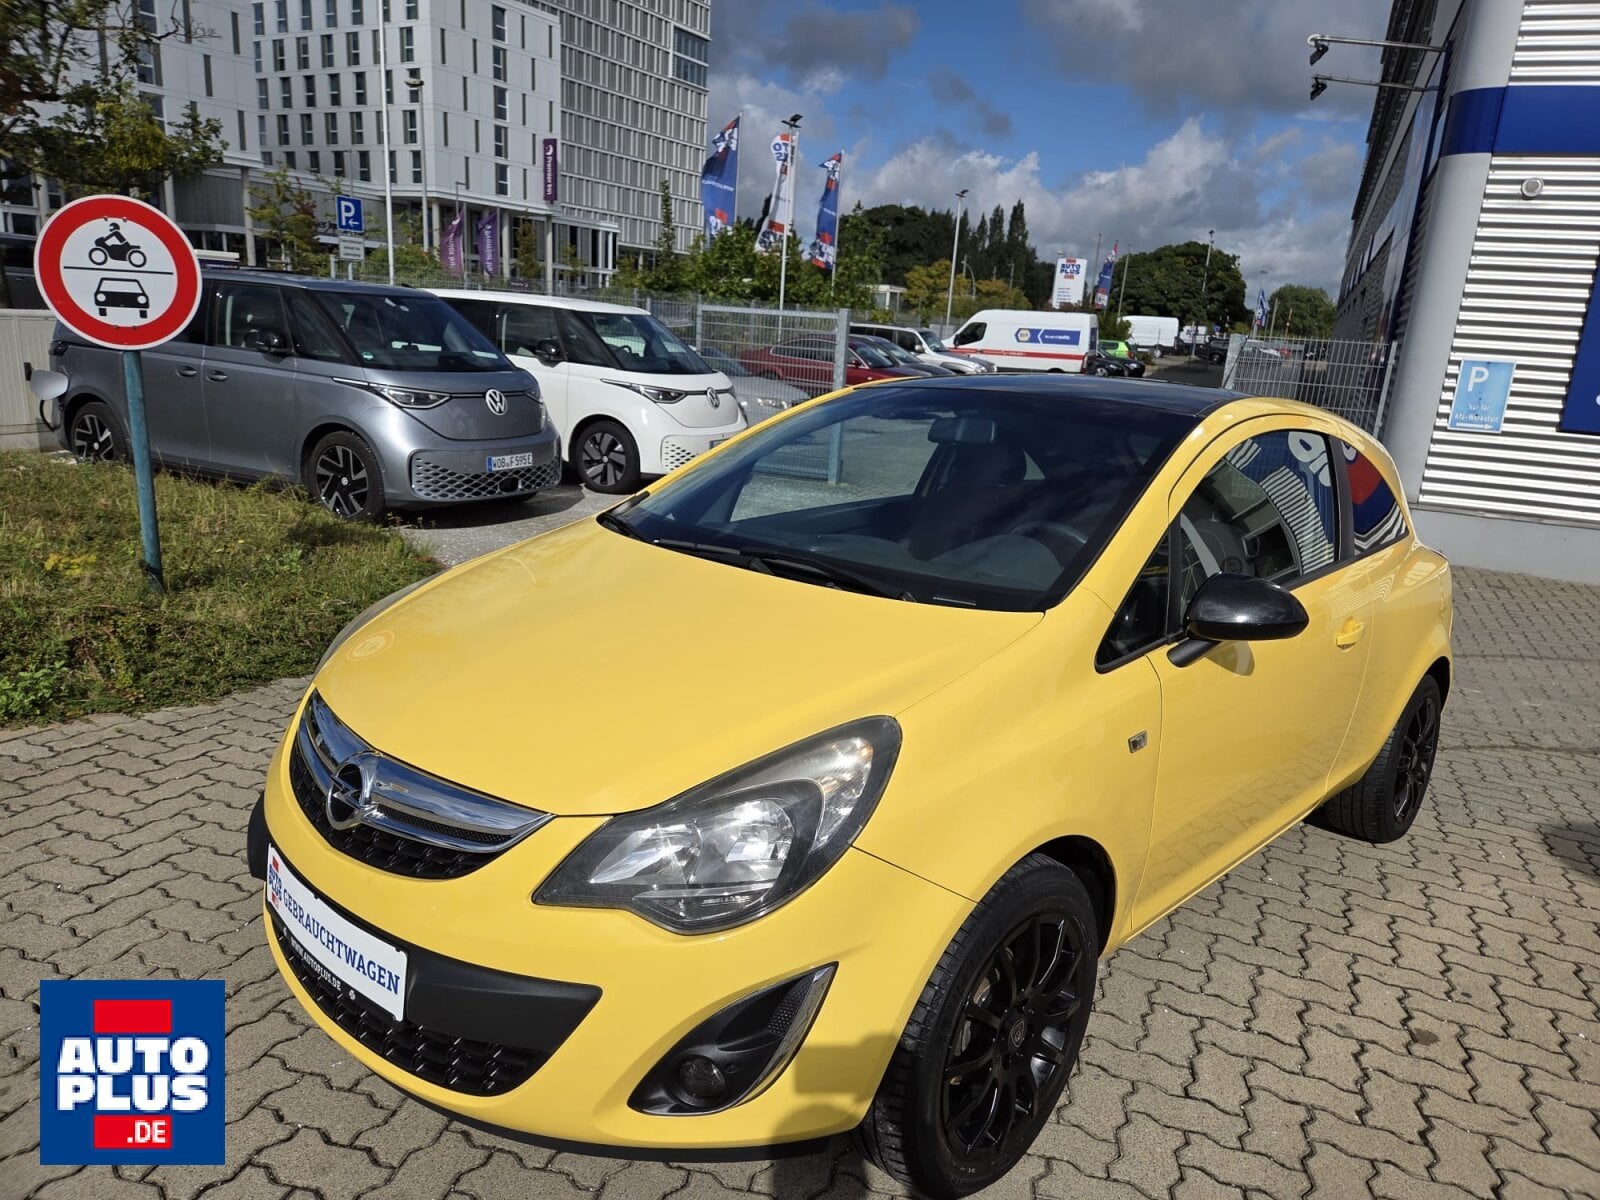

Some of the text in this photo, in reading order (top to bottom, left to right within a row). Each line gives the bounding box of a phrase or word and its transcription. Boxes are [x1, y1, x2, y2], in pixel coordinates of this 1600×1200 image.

[340, 200, 355, 226] P
[1467, 366, 1489, 392] P
[283, 888, 401, 996] GEBRAUCHTWAGEN
[289, 935, 343, 992] WWW.AUTOPLUS.DE
